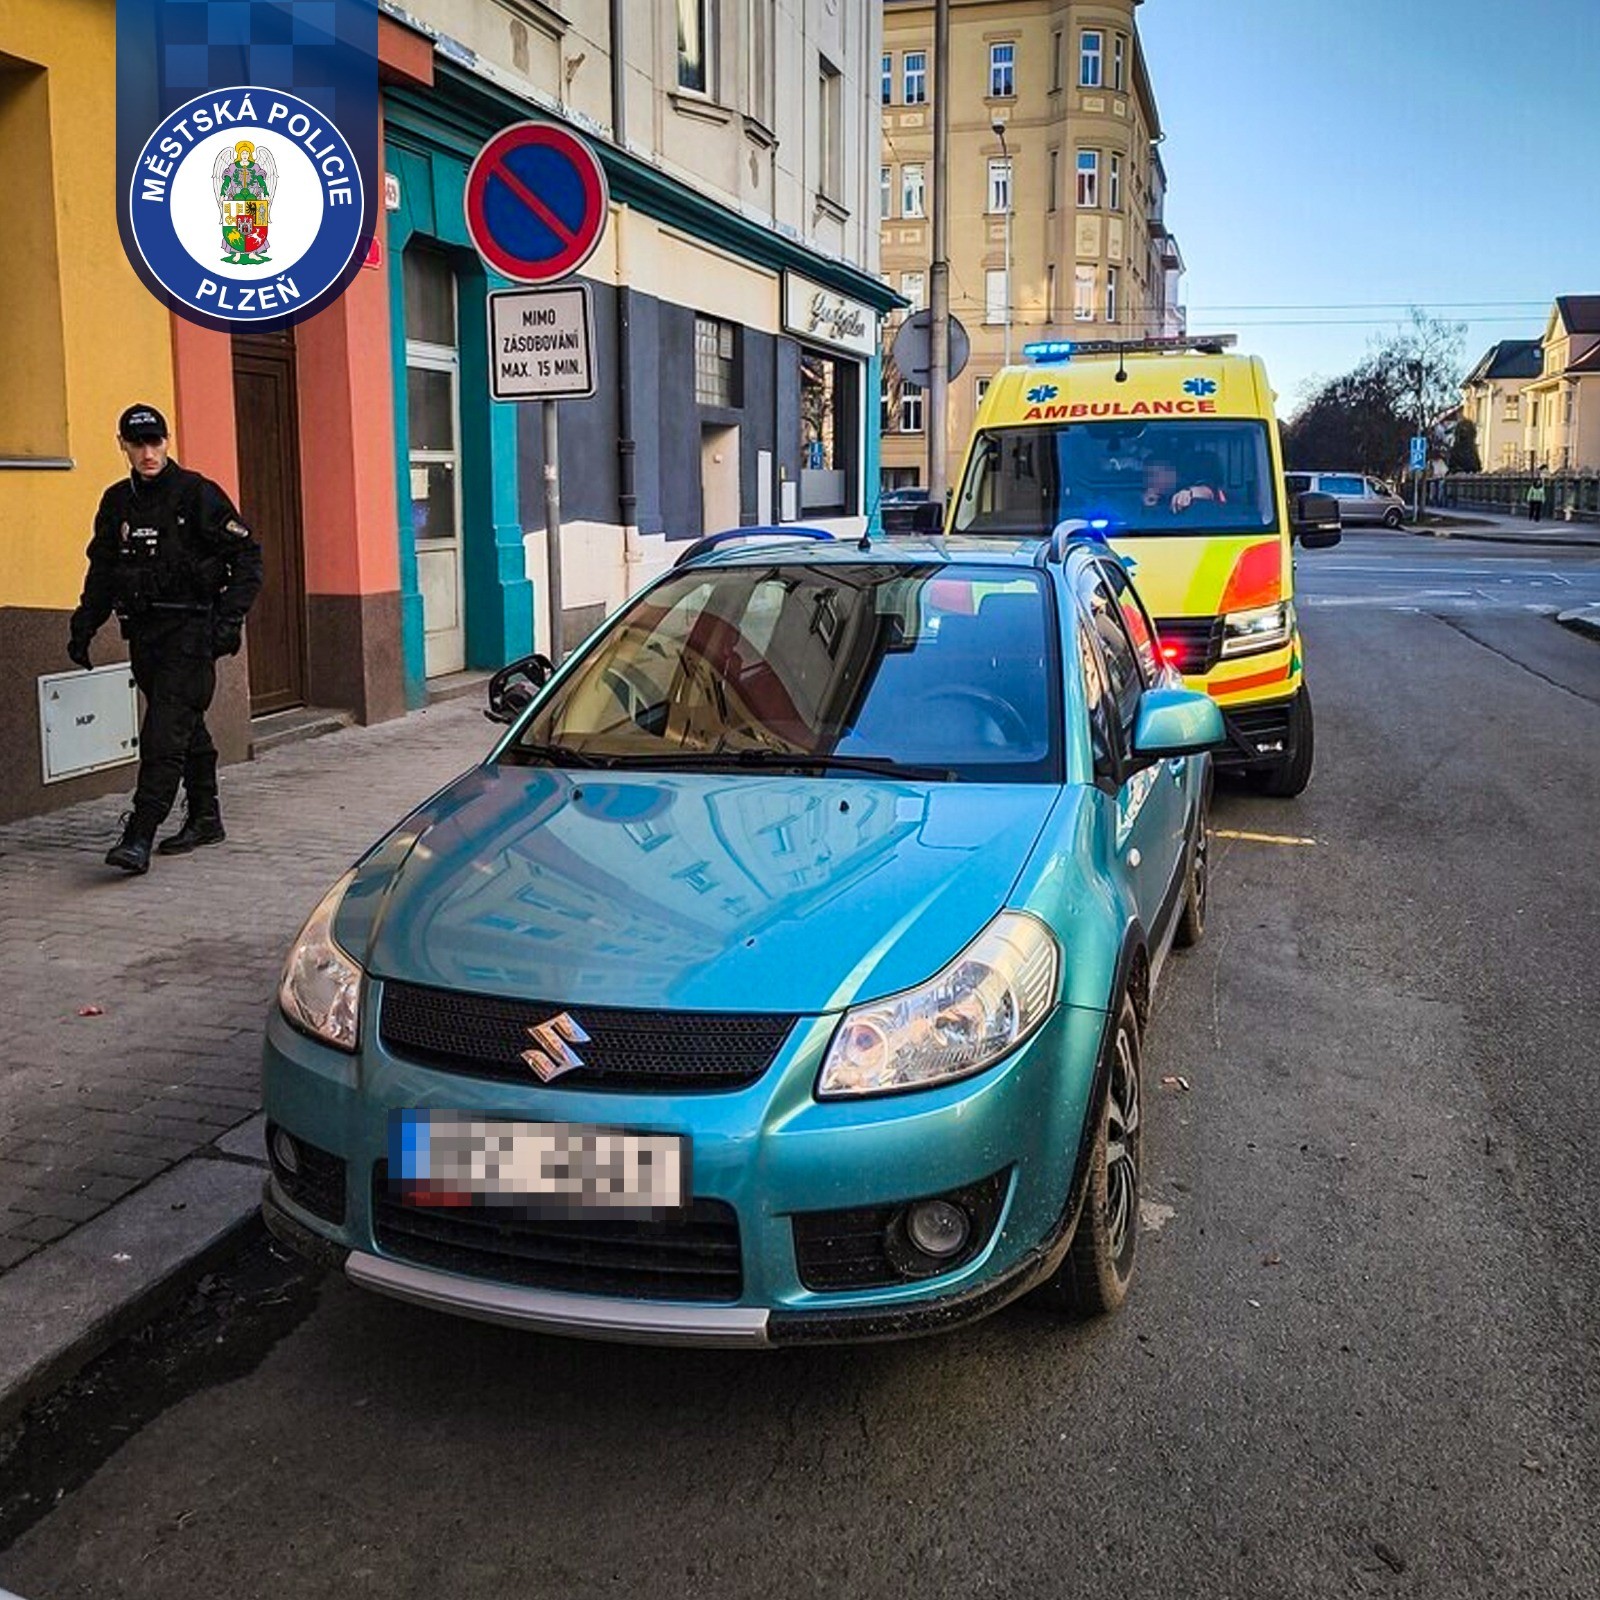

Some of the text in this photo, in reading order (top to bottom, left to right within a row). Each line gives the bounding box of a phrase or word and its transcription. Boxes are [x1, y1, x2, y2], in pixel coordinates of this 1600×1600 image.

[522, 308, 556, 326] MIMO
[503, 329, 579, 353] ZÁSOBOVÁNÍ
[501, 358, 583, 378] MAX. 15 MIN.
[1023, 400, 1217, 421] AMBULANCE
